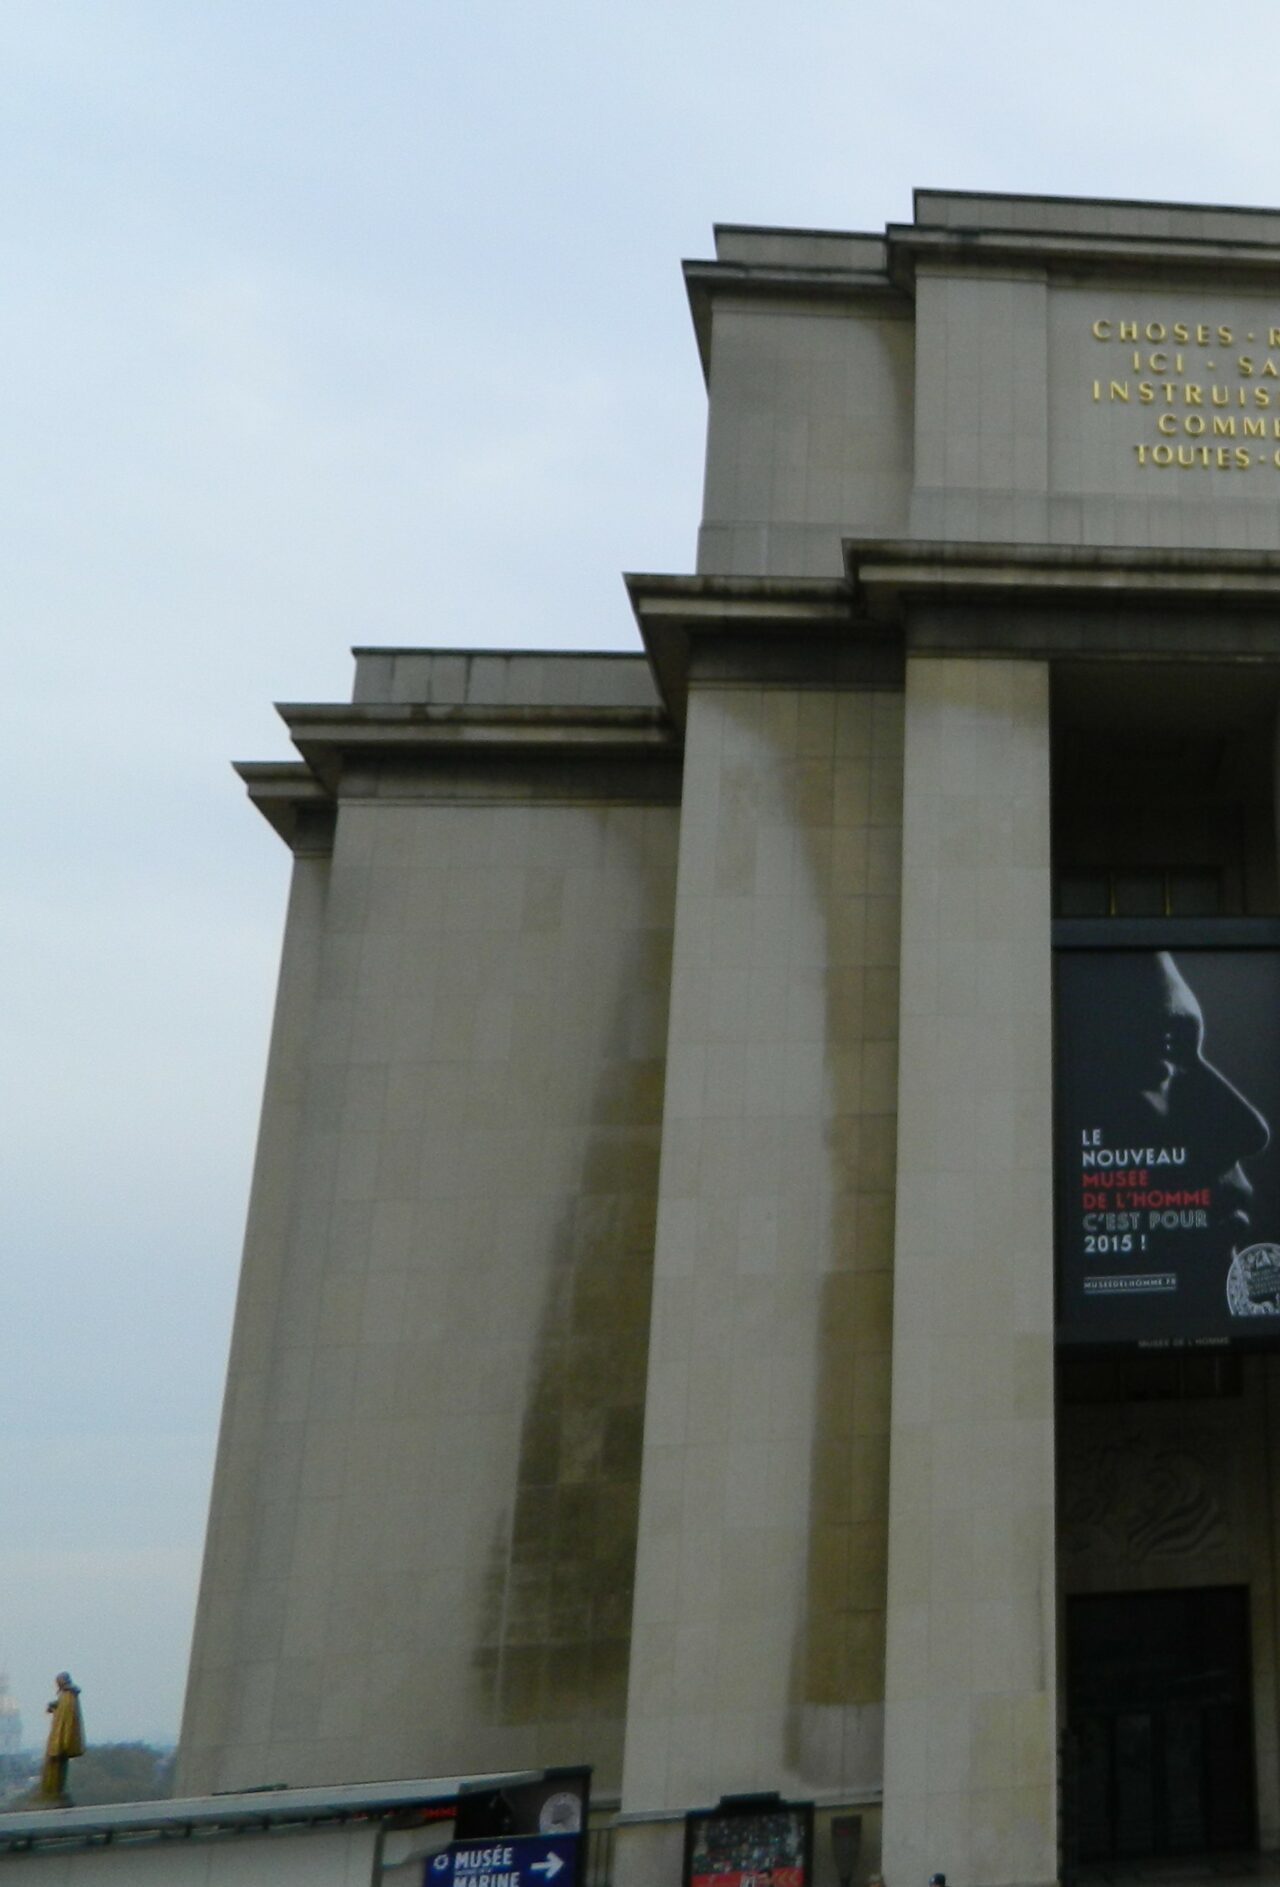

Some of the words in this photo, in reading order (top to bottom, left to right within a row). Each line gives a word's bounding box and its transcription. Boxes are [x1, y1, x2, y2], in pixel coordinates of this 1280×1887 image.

[1092, 319, 1233, 345] CHOSES
[1133, 352, 1185, 374] ICI
[1134, 444, 1250, 470] TOUTES
[1082, 1129, 1101, 1146] LE
[1082, 1147, 1186, 1167] NOUVEAU
[1082, 1192, 1107, 1210] DE
[1116, 1188, 1210, 1209] L'HOMME
[1082, 1212, 1140, 1231] C'EST
[1149, 1209, 1208, 1229] POUR
[1084, 1234, 1133, 1252] 2015
[453, 1845, 513, 1869] MUSÉE
[452, 1872, 520, 1887] MARINE
